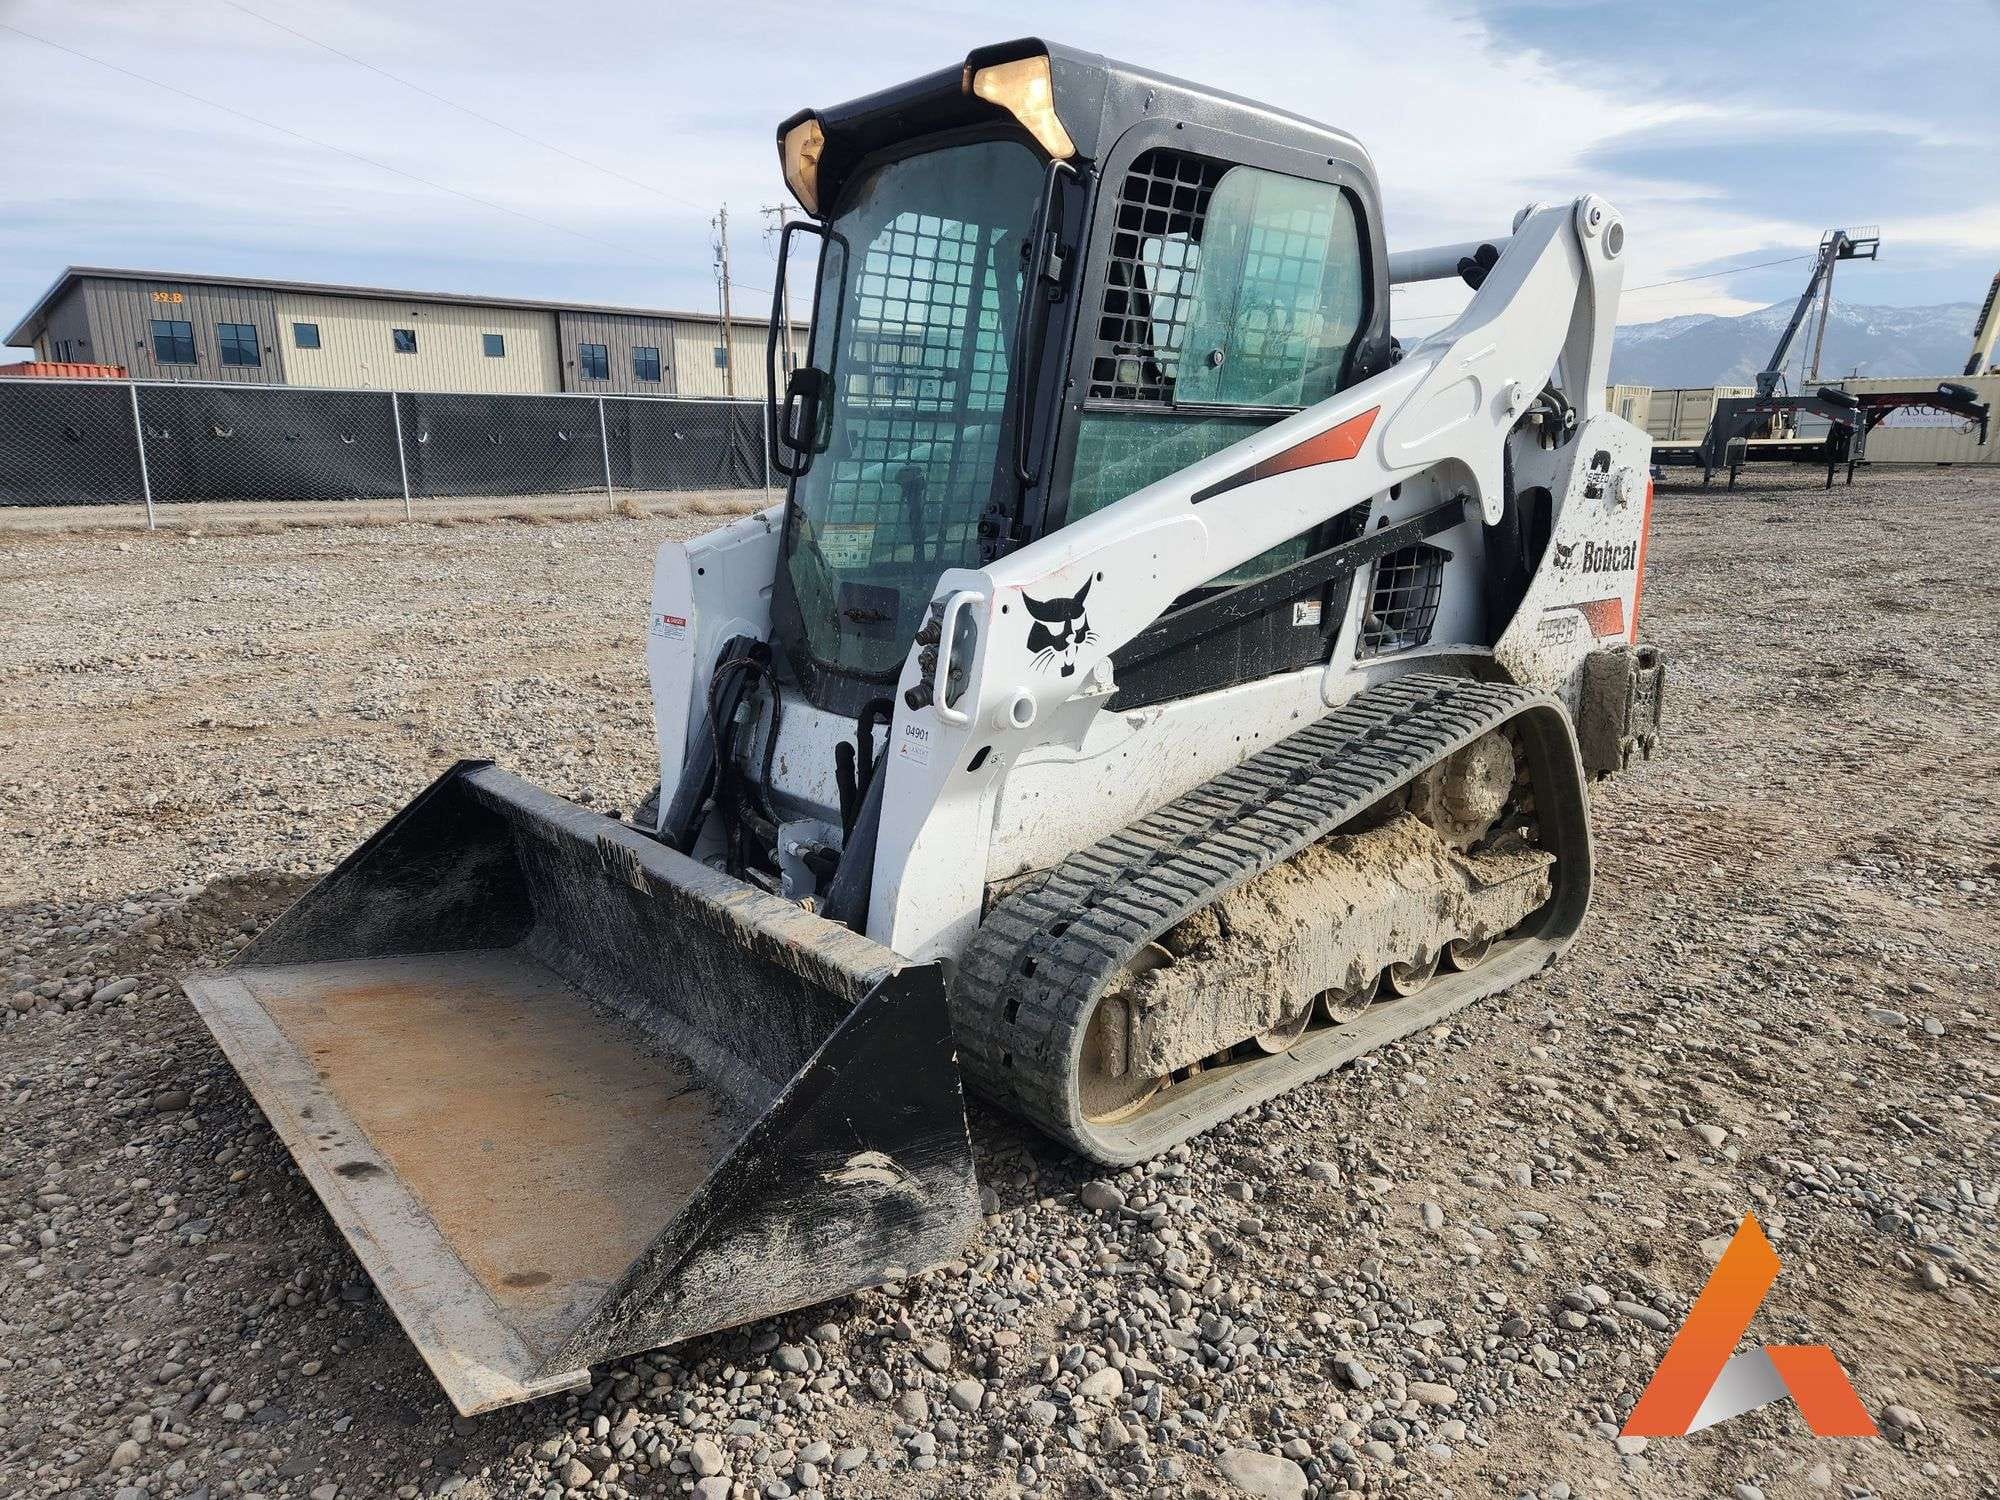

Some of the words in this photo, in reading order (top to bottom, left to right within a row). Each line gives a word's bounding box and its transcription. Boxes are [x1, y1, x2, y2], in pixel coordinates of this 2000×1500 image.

[1587, 473, 1610, 483] SPEED
[1582, 540, 1636, 573] Bobcat
[905, 724, 928, 741] 04901
